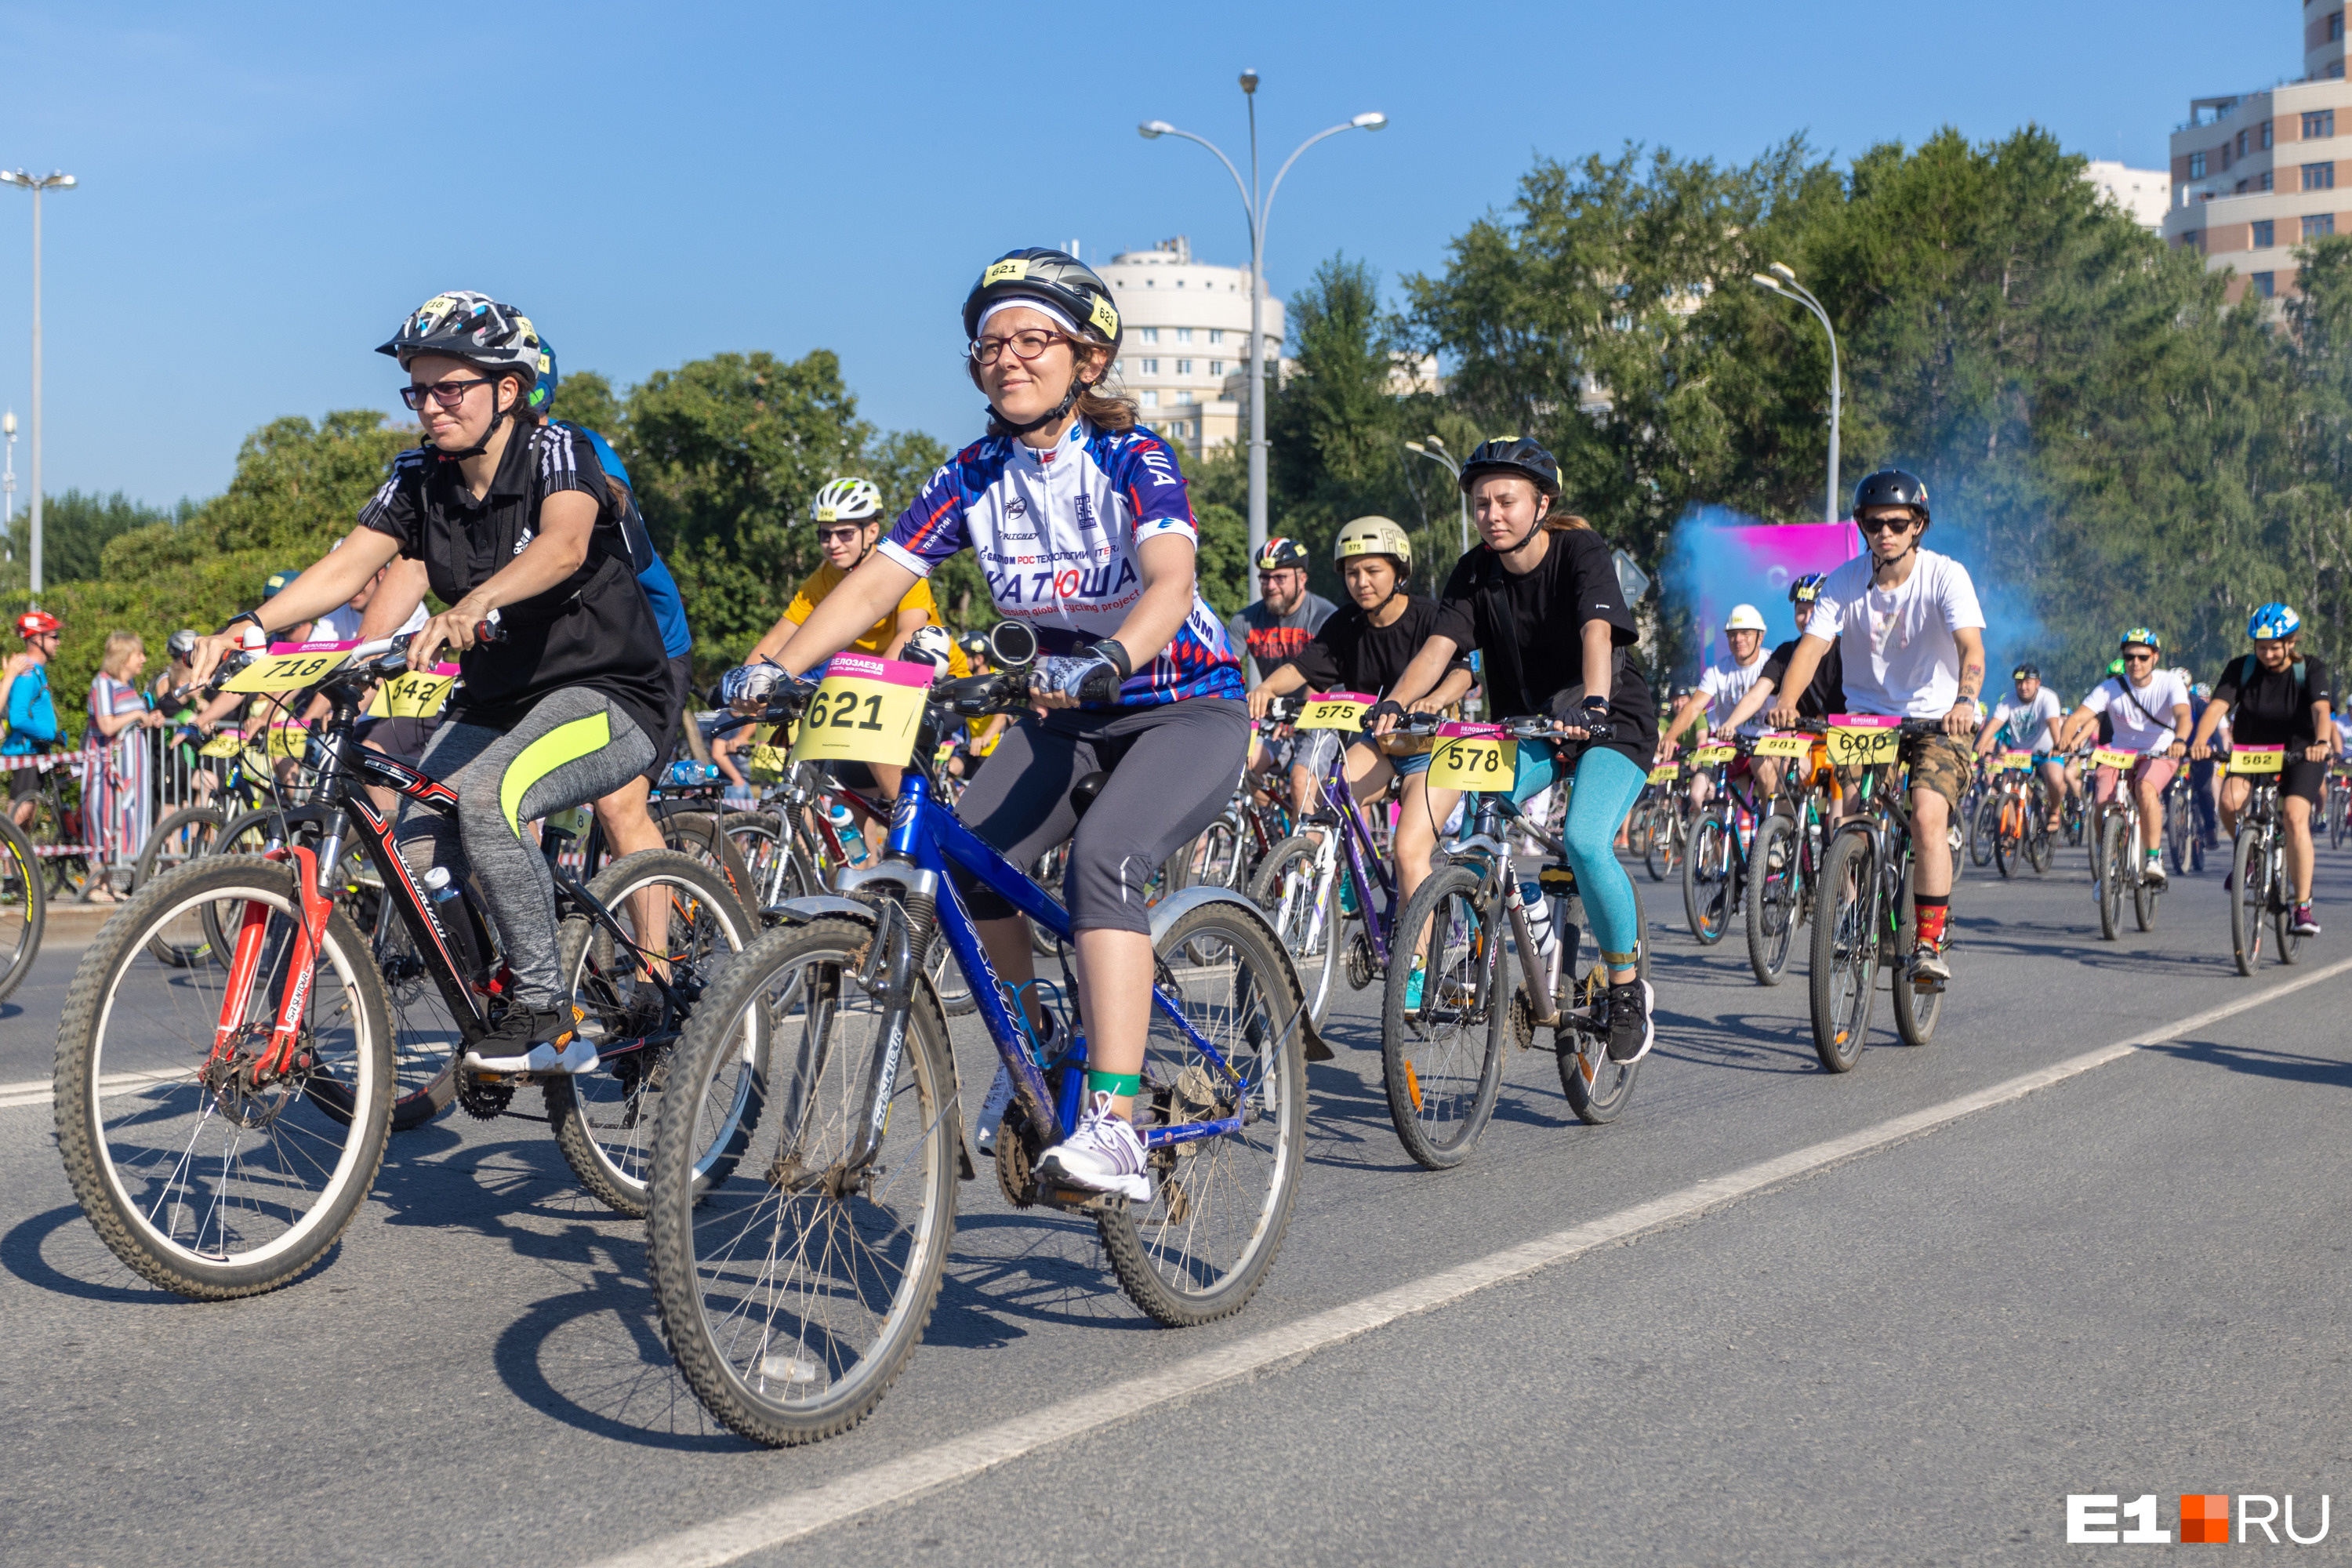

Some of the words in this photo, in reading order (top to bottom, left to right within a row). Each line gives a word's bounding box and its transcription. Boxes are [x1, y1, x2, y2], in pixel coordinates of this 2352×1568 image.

[992, 265, 1017, 277] 621
[1099, 307, 1114, 328] 621
[1003, 532, 1040, 540] RITCHEY
[985, 557, 1138, 604] КАТЮША
[1063, 602, 1100, 614] cycling
[1101, 588, 1141, 613] project
[263, 658, 328, 679] 718
[830, 658, 884, 673] ВЕЛОЗАЕЗД
[392, 679, 437, 702] 542
[809, 691, 884, 731] 621
[1315, 705, 1356, 719] 575
[1839, 734, 1887, 750] 600
[1447, 746, 1499, 773] 578
